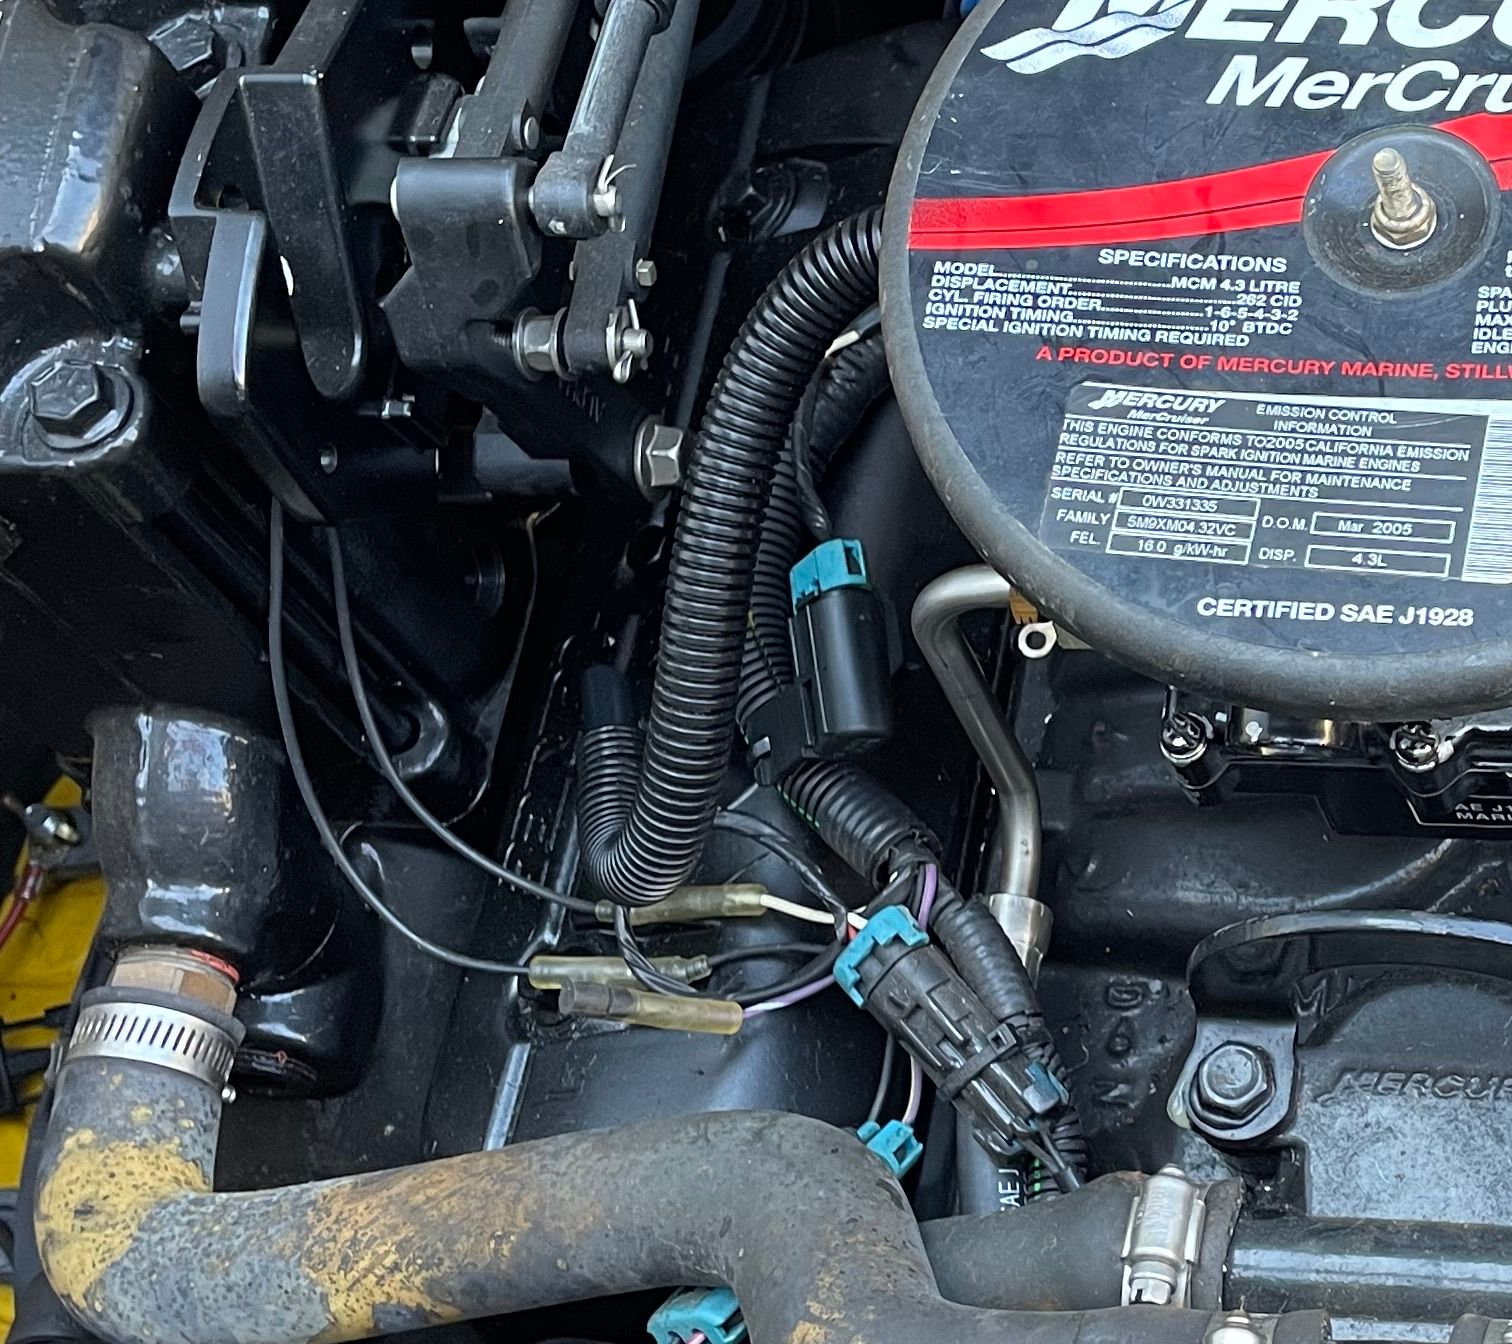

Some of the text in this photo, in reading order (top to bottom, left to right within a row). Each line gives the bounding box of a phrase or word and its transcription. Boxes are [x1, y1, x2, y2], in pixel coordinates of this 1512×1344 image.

[1098, 249, 1287, 272] SPECIFICATIONS
[931, 275, 1302, 308] DISPLACEMENT 262 CID
[934, 261, 1301, 295] MODEL MCM 4.3 LITRE
[926, 303, 1006, 321] IGNITION
[1009, 308, 1073, 324] TIMING
[1242, 320, 1294, 336] BTDC
[928, 289, 1299, 321] CYL. FIRING ORDER 1-6-5-4-3-2
[923, 317, 1250, 347] SPECIAL IGNITION TIMING REQUIRED
[1036, 346, 1053, 362] A
[1057, 347, 1175, 367] PRODUCT
[1180, 354, 1211, 370] OF
[1217, 357, 1336, 376] MERCURY
[1341, 361, 1438, 381] MARINE,
[1088, 389, 1397, 425] MERCURY EMISSION CONTROL
[1127, 409, 1373, 437] MerCruiser INFORMATION
[1059, 433, 1420, 473] REGULATIONS FOR SPARK IGNITION MARINE ENGINES
[1062, 419, 1094, 433] THIS
[1097, 422, 1154, 439] ENGINE
[1156, 427, 1243, 446] CONFORMS
[1305, 440, 1393, 458] CALIFORNIA
[1397, 446, 1470, 463] EMISSION
[1051, 465, 1319, 499] SPECIFICATIONS AND ADJUSTMENTS
[1055, 452, 1412, 492] REFER TO OWNER'S MANUAL FOR MAINTENANCE
[1050, 487, 1106, 504] SERIAL
[1056, 509, 1110, 526] FAMILY
[1261, 516, 1413, 536] D.O.M. Mar 2005
[1259, 547, 1389, 568] DISP. 4.3L
[1197, 596, 1475, 627] CERTIFIED SAE J1928
[998, 1181, 1021, 1213] AE
